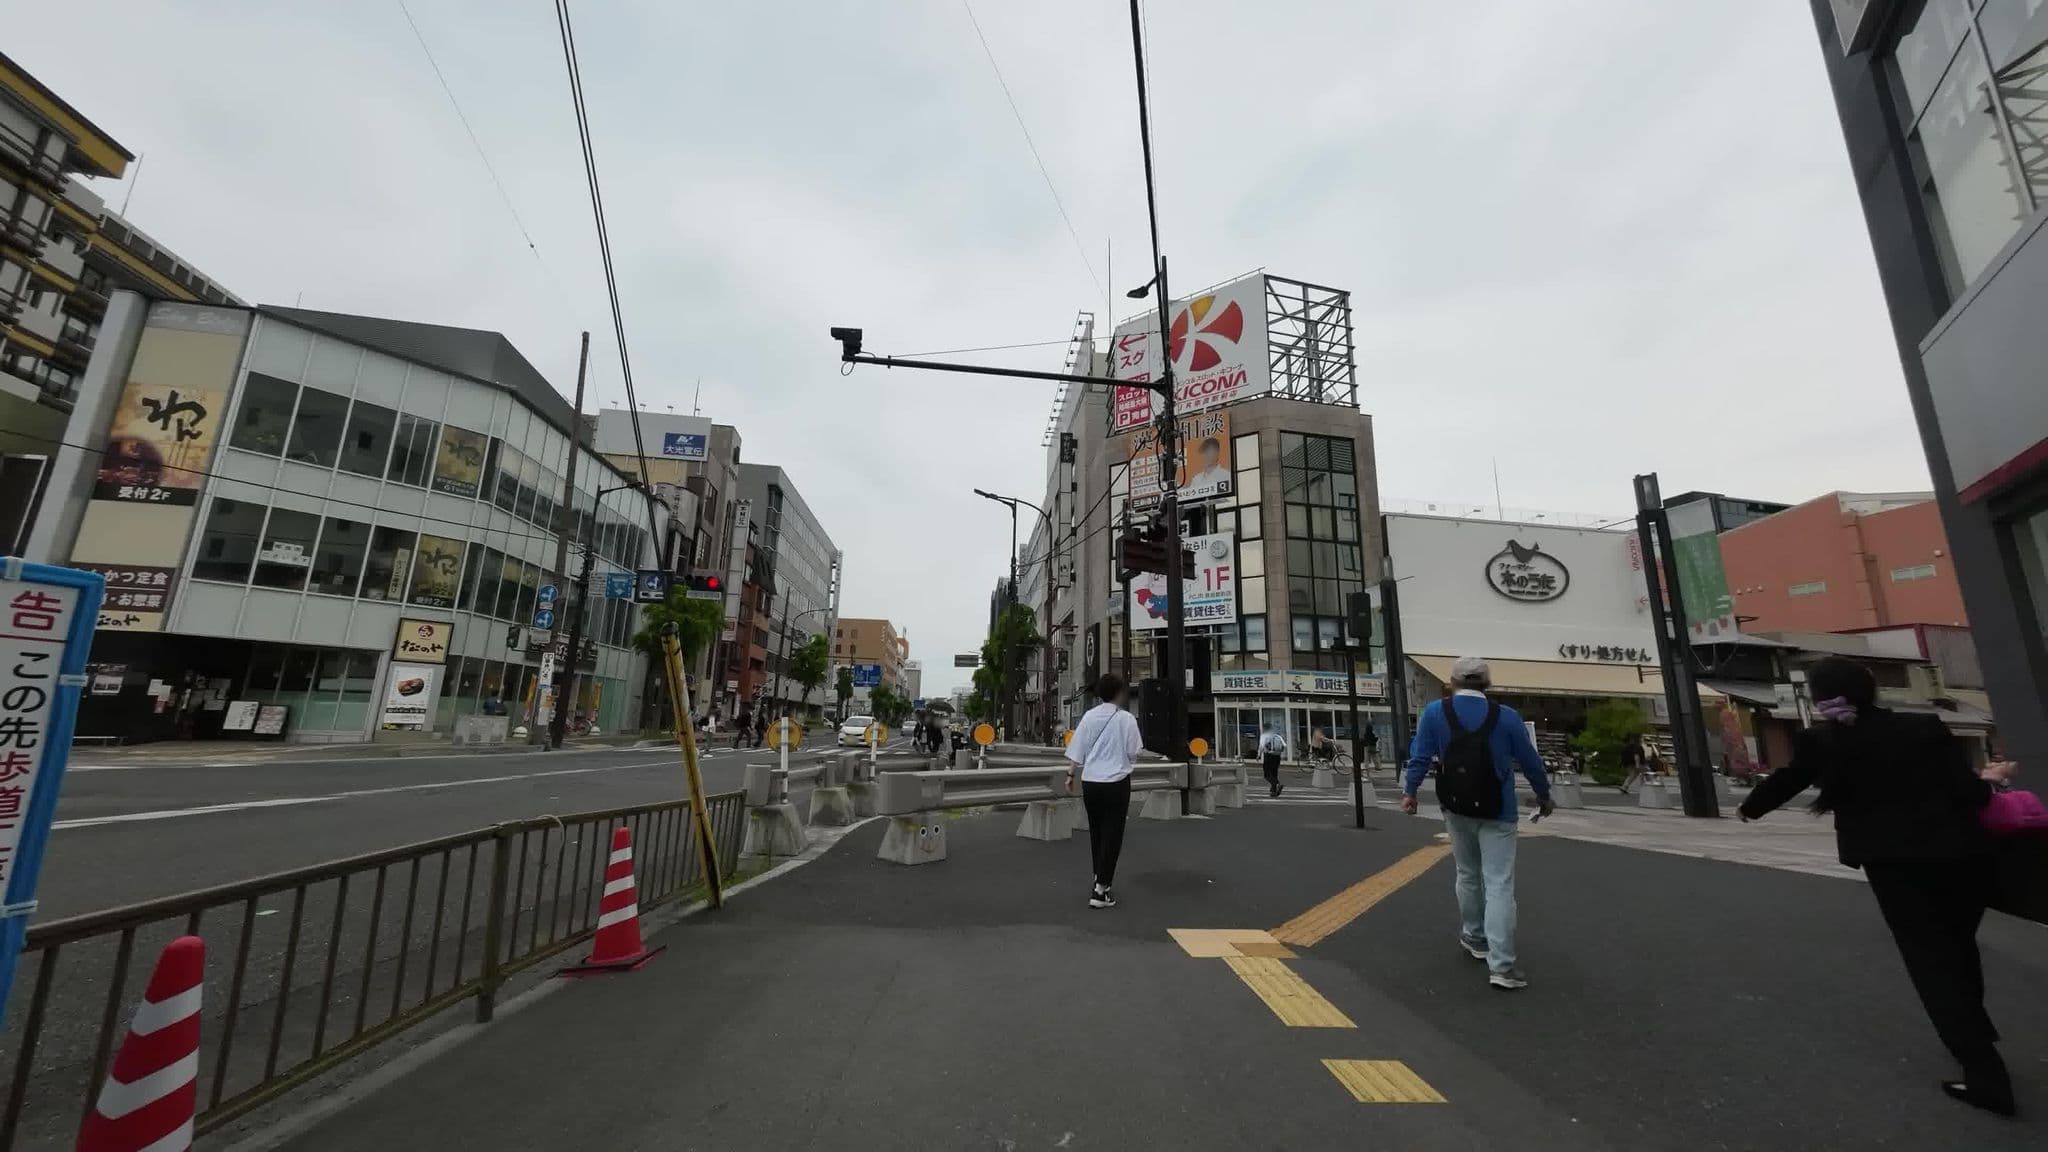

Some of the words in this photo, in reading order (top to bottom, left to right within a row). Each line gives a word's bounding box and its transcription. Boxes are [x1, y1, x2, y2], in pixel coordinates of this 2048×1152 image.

[142, 389, 207, 441] わん
[117, 486, 172, 501] 受付2F
[1182, 538, 1207, 551] なら!!
[1204, 566, 1230, 592] 1F
[1224, 677, 1265, 689] 賃貸住宅
